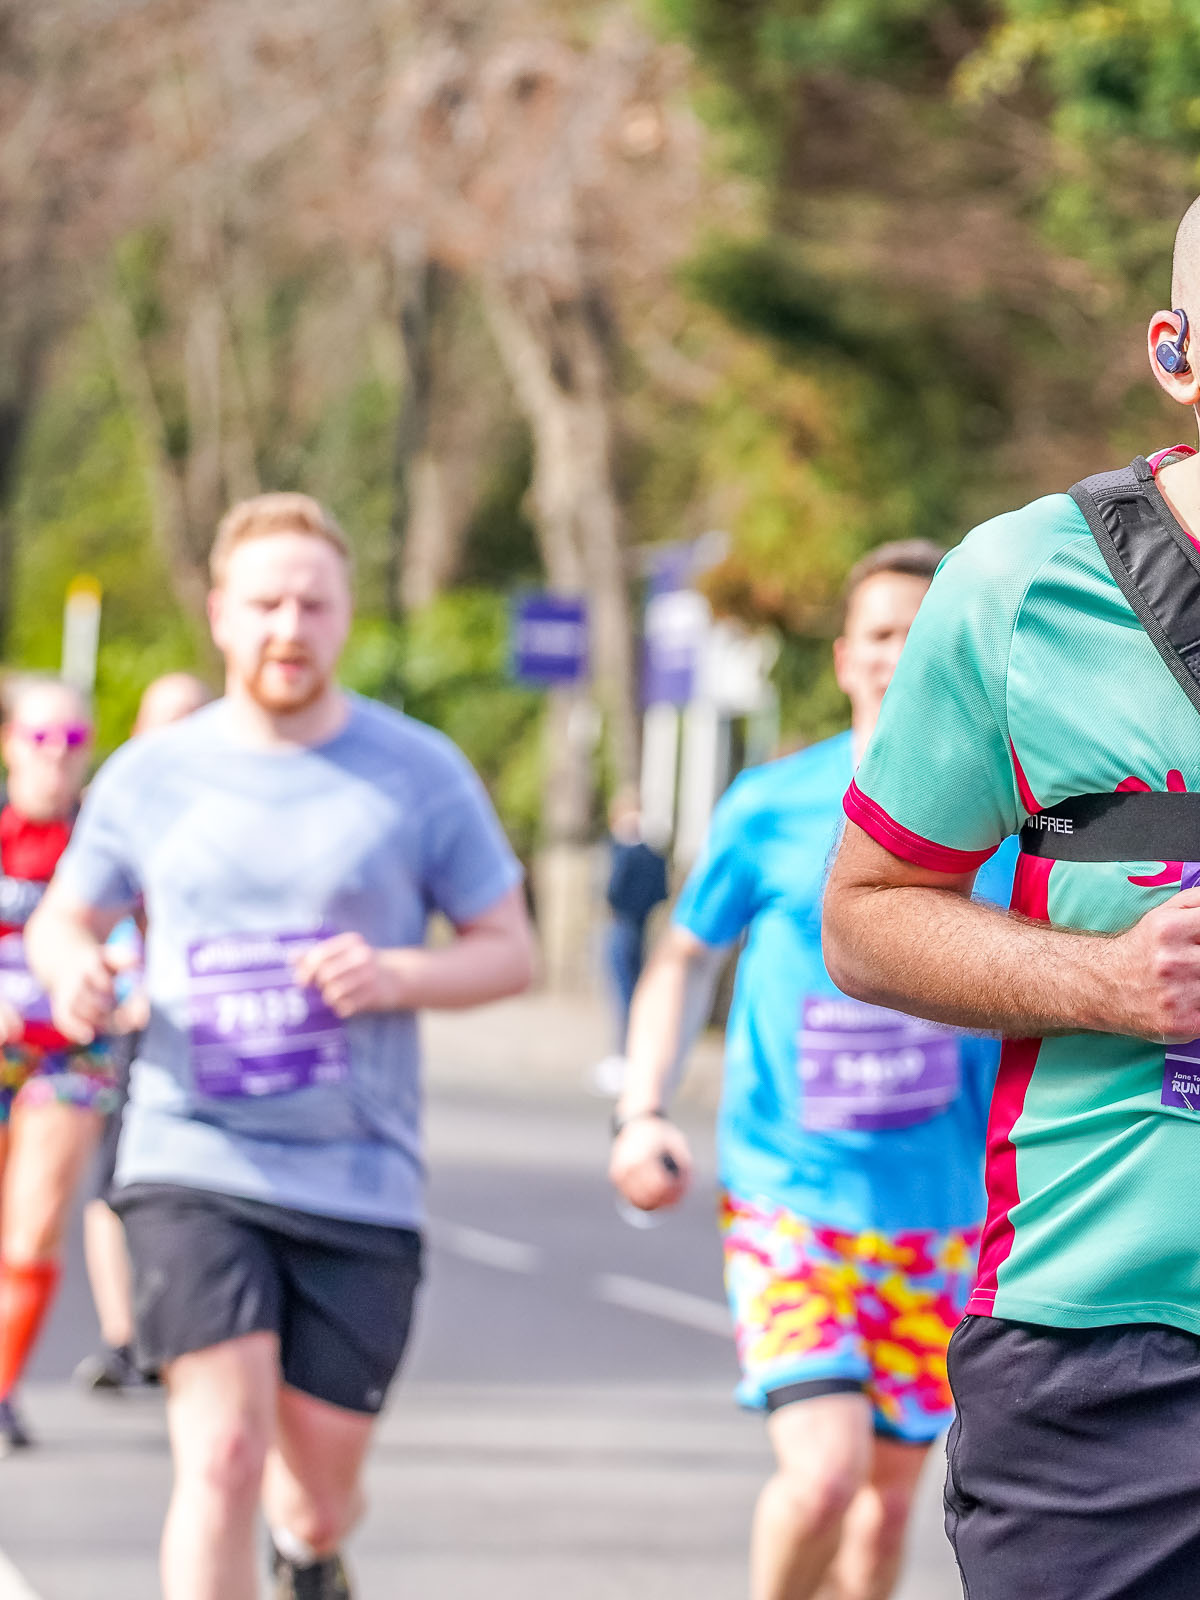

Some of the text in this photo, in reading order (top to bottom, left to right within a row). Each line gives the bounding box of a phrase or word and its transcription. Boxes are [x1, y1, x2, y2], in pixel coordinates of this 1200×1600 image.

[1040, 815, 1073, 834] FREE
[1174, 1071, 1192, 1081] Jane
[1171, 1080, 1200, 1095] RUN
